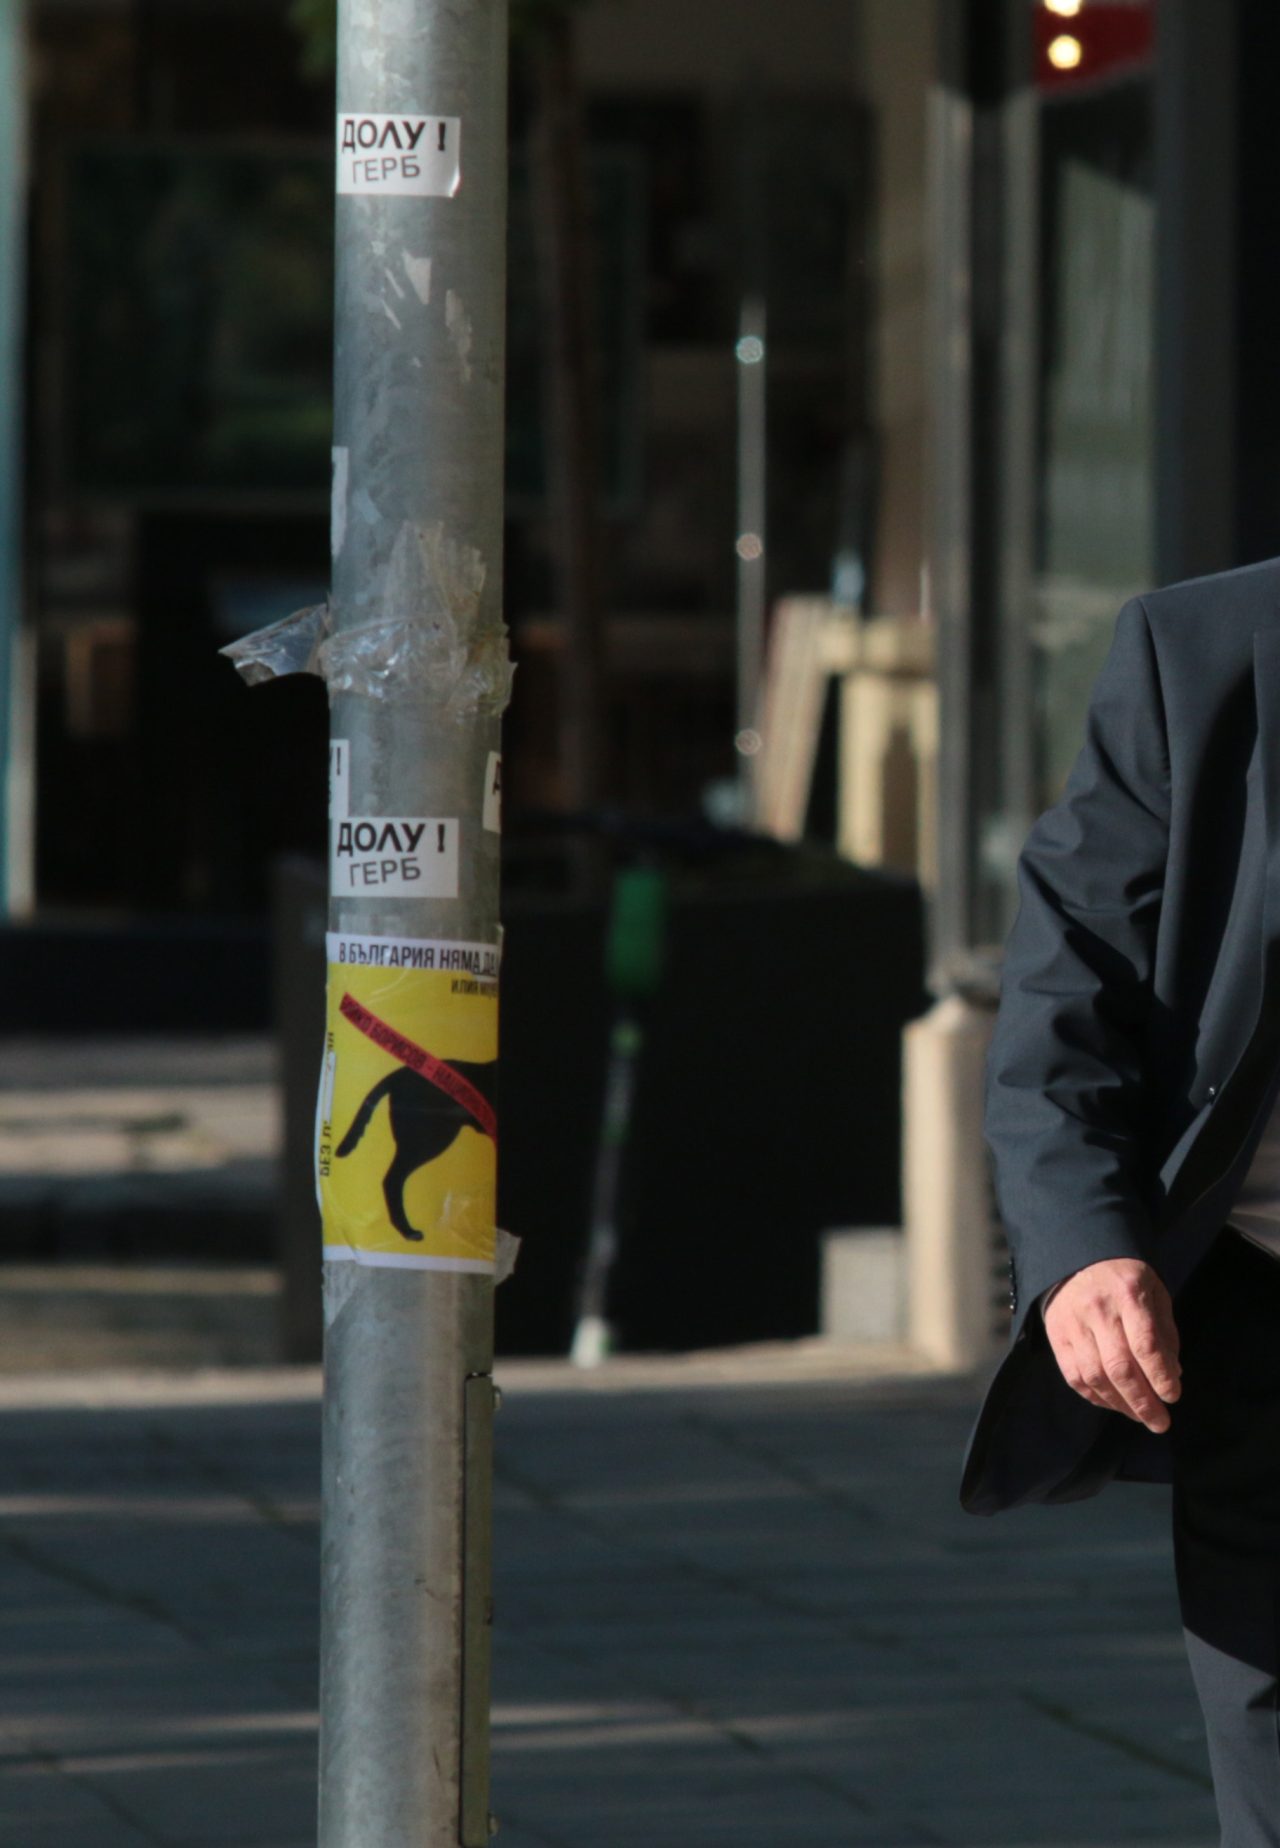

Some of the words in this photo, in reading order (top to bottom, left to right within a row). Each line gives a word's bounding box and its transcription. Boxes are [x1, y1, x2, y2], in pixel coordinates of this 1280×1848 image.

[342, 120, 425, 152] ДОЛУ
[353, 155, 420, 183] ГЕРБ
[337, 823, 425, 857] ДОЛУ
[350, 857, 420, 887] ГЕРБ
[339, 943, 346, 962] В
[350, 943, 434, 970] БЪЛГАРИЯ
